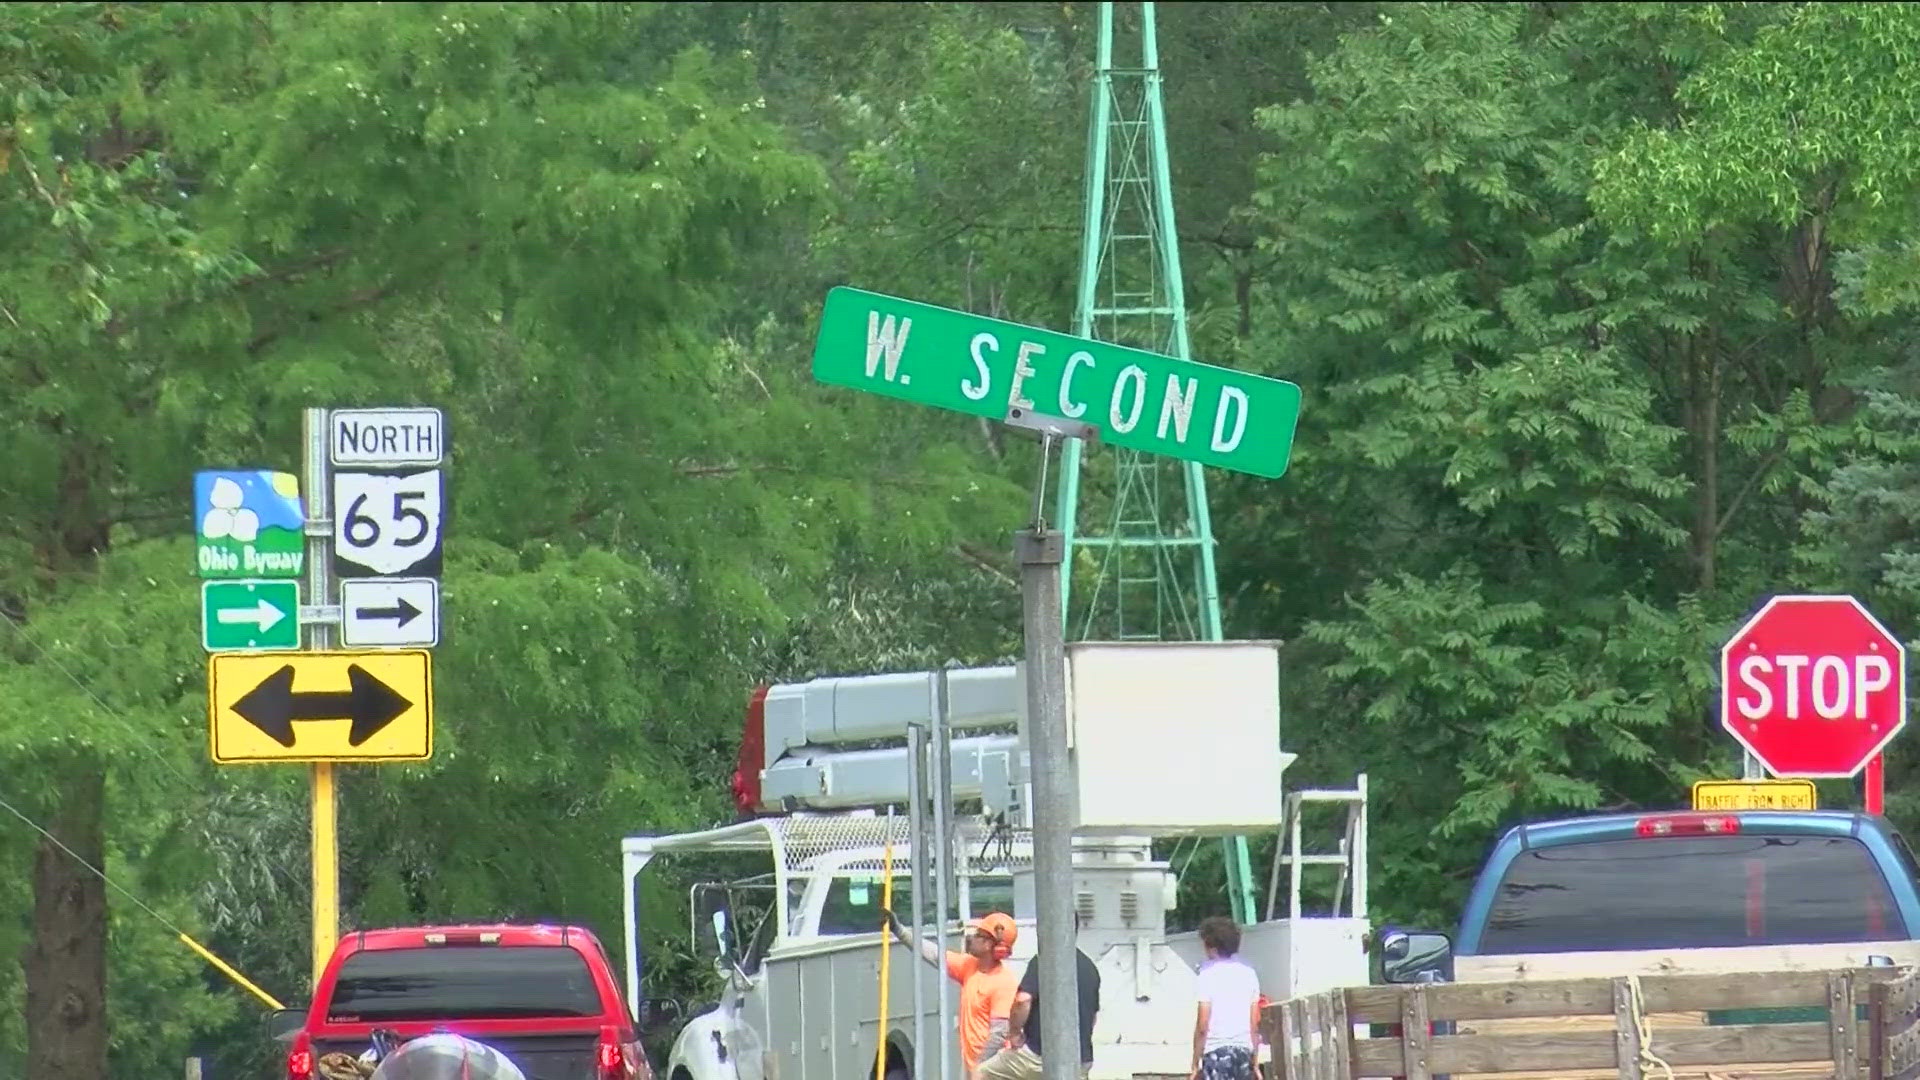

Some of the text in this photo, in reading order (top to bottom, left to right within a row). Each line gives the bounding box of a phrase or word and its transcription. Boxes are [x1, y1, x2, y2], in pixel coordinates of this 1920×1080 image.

[864, 309, 1250, 454] W. SECOND
[340, 421, 432, 453] NORTH
[343, 491, 430, 548] 65
[198, 544, 304, 575] Ohio Byway
[1736, 654, 1892, 720] STOP
[1700, 794, 1809, 809] TRAFFIC FROM RIGHT
